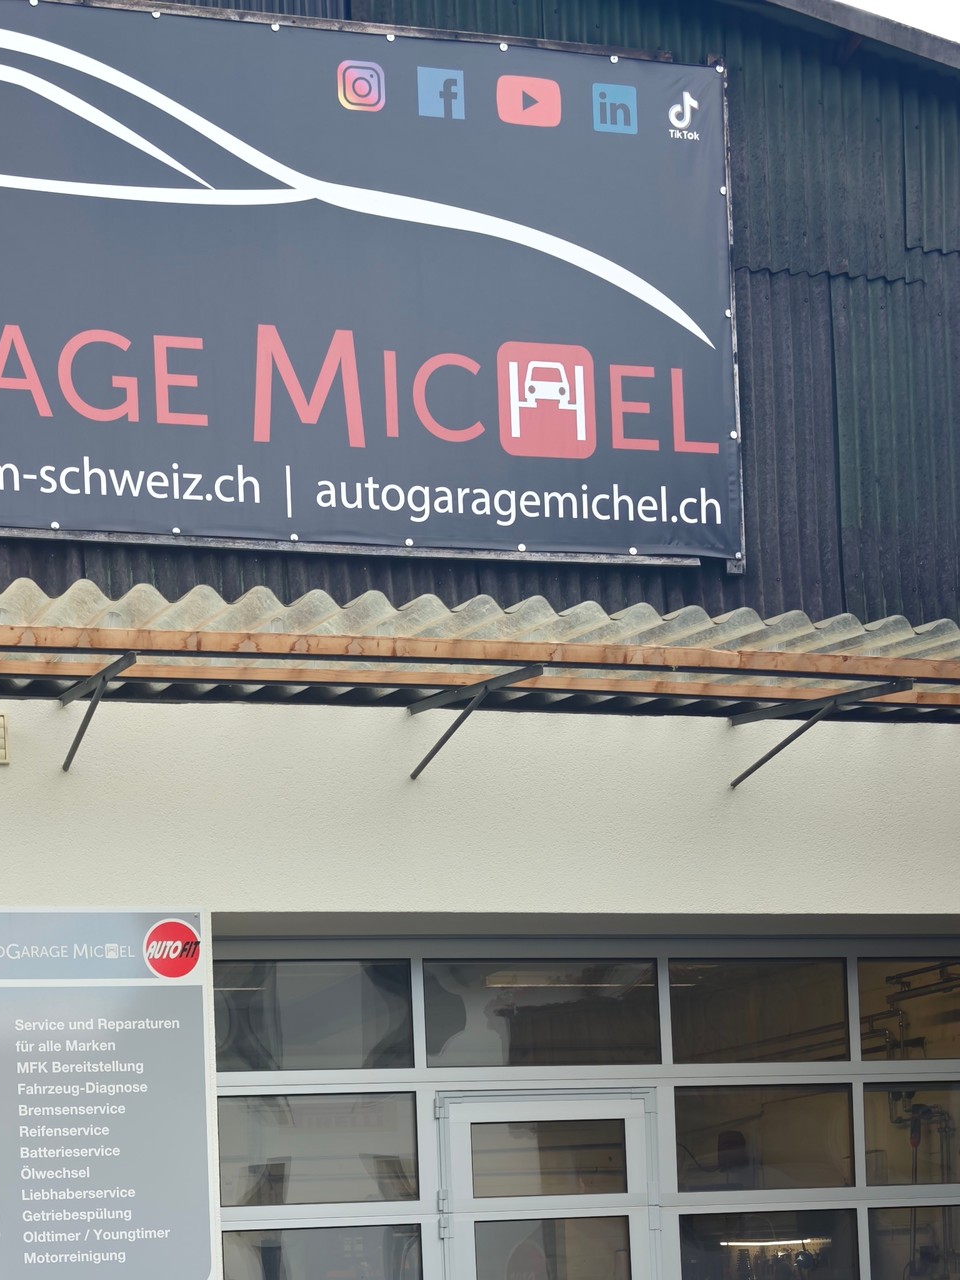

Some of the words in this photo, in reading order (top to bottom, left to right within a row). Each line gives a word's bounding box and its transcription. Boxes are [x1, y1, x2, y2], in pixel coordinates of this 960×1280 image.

[669, 129, 700, 141] TikTok
[317, 481, 722, 527] autogaragemichel.ch
[14, 1018, 65, 1031] Service
[68, 1018, 94, 1031] und
[97, 1017, 180, 1033] Reparaturen
[15, 1040, 35, 1053] für
[37, 1040, 62, 1052] alle
[65, 1039, 116, 1052] Marken
[16, 1061, 48, 1074] MFK
[51, 1059, 144, 1075] Bereitstellung
[17, 1081, 148, 1097] Fahrzeug-Diagnose
[18, 1103, 126, 1116] Bremsenservice
[19, 1124, 110, 1138] Reifenservice
[20, 1145, 121, 1159] Batterieservice
[20, 1165, 91, 1180] Ölwechsel
[21, 1186, 136, 1201] Liebhaberservice
[22, 1208, 132, 1223] Getriebespülung
[22, 1229, 81, 1243] Oldtimer
[92, 1228, 171, 1243] Youngtimer
[23, 1250, 127, 1265] Motorreinigung
